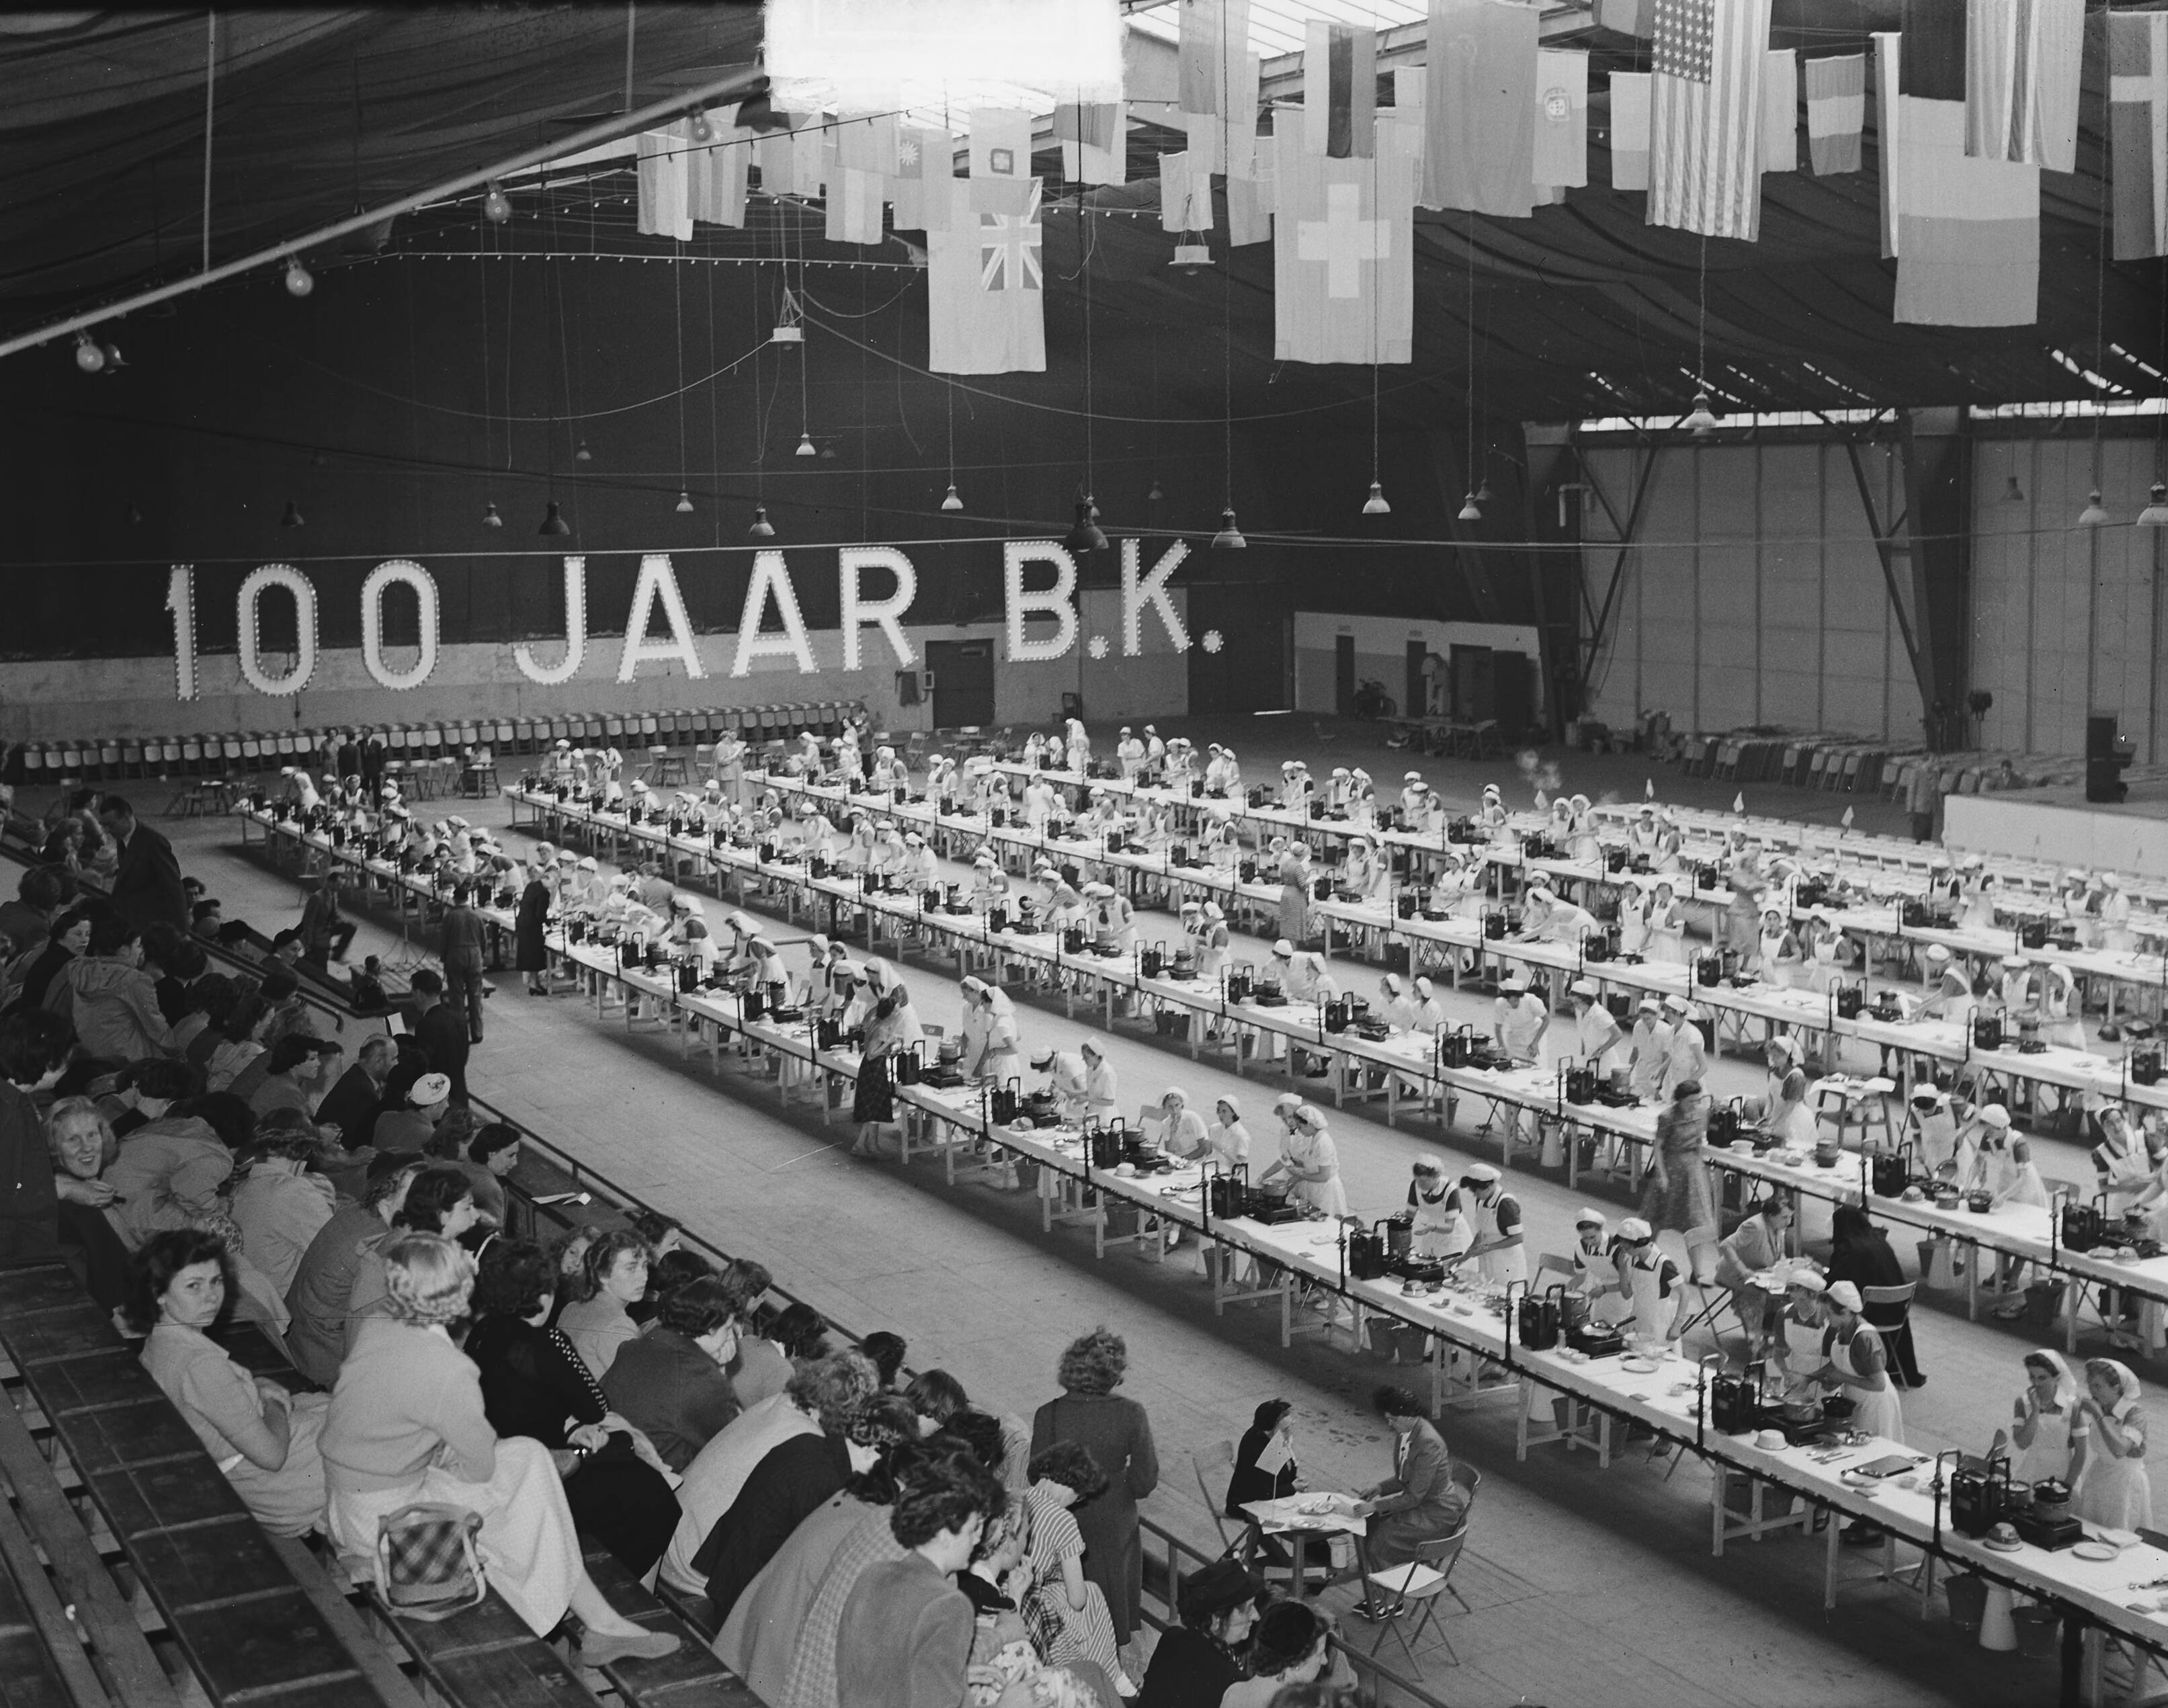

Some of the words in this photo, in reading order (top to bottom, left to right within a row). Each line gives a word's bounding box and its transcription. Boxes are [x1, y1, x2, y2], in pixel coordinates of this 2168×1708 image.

[165, 559, 441, 700] 100
[513, 546, 919, 685] JAAR
[1004, 538, 1224, 662] B.K.
